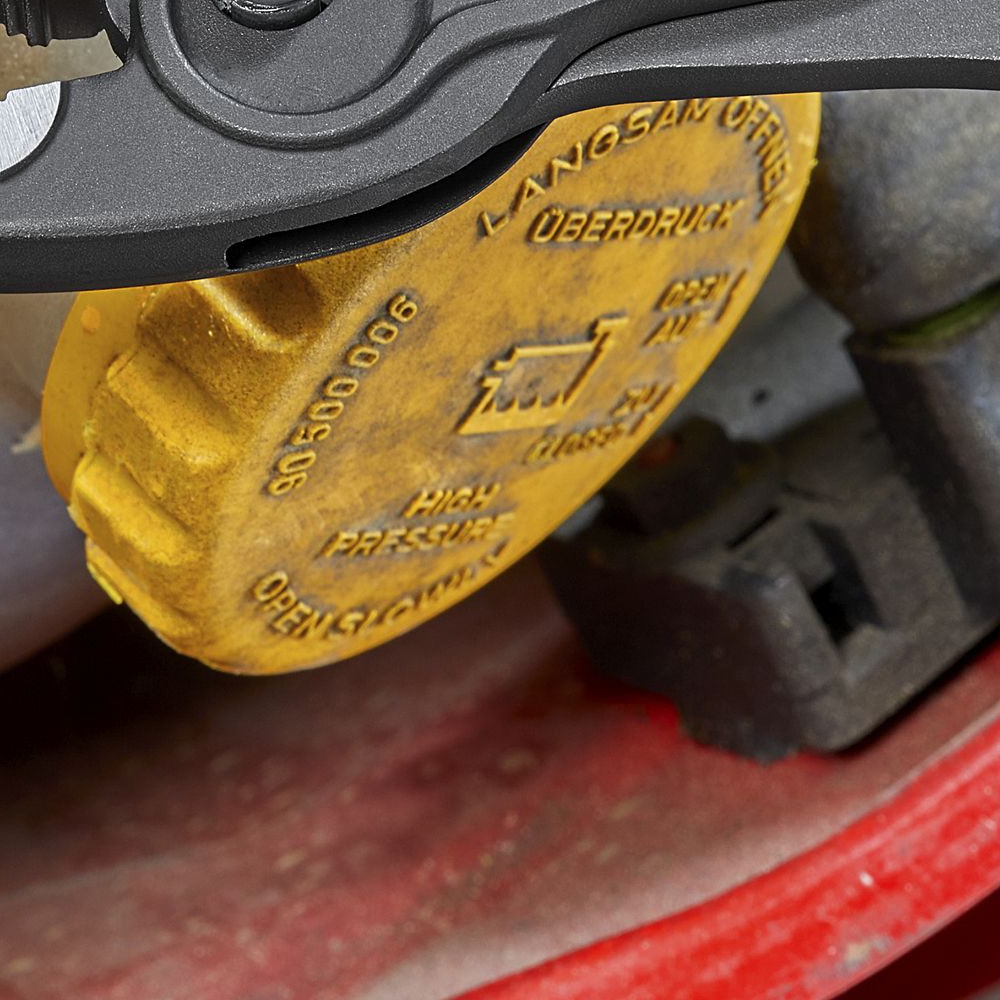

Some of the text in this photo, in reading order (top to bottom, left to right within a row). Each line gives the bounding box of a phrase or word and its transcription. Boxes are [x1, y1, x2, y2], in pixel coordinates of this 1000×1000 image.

[477, 98, 711, 237] LANGSAM
[529, 200, 744, 244] ÜBERDRUCK
[402, 483, 500, 519] HIGH
[316, 512, 515, 560] PRESSURE
[250, 569, 334, 640] OPEN
